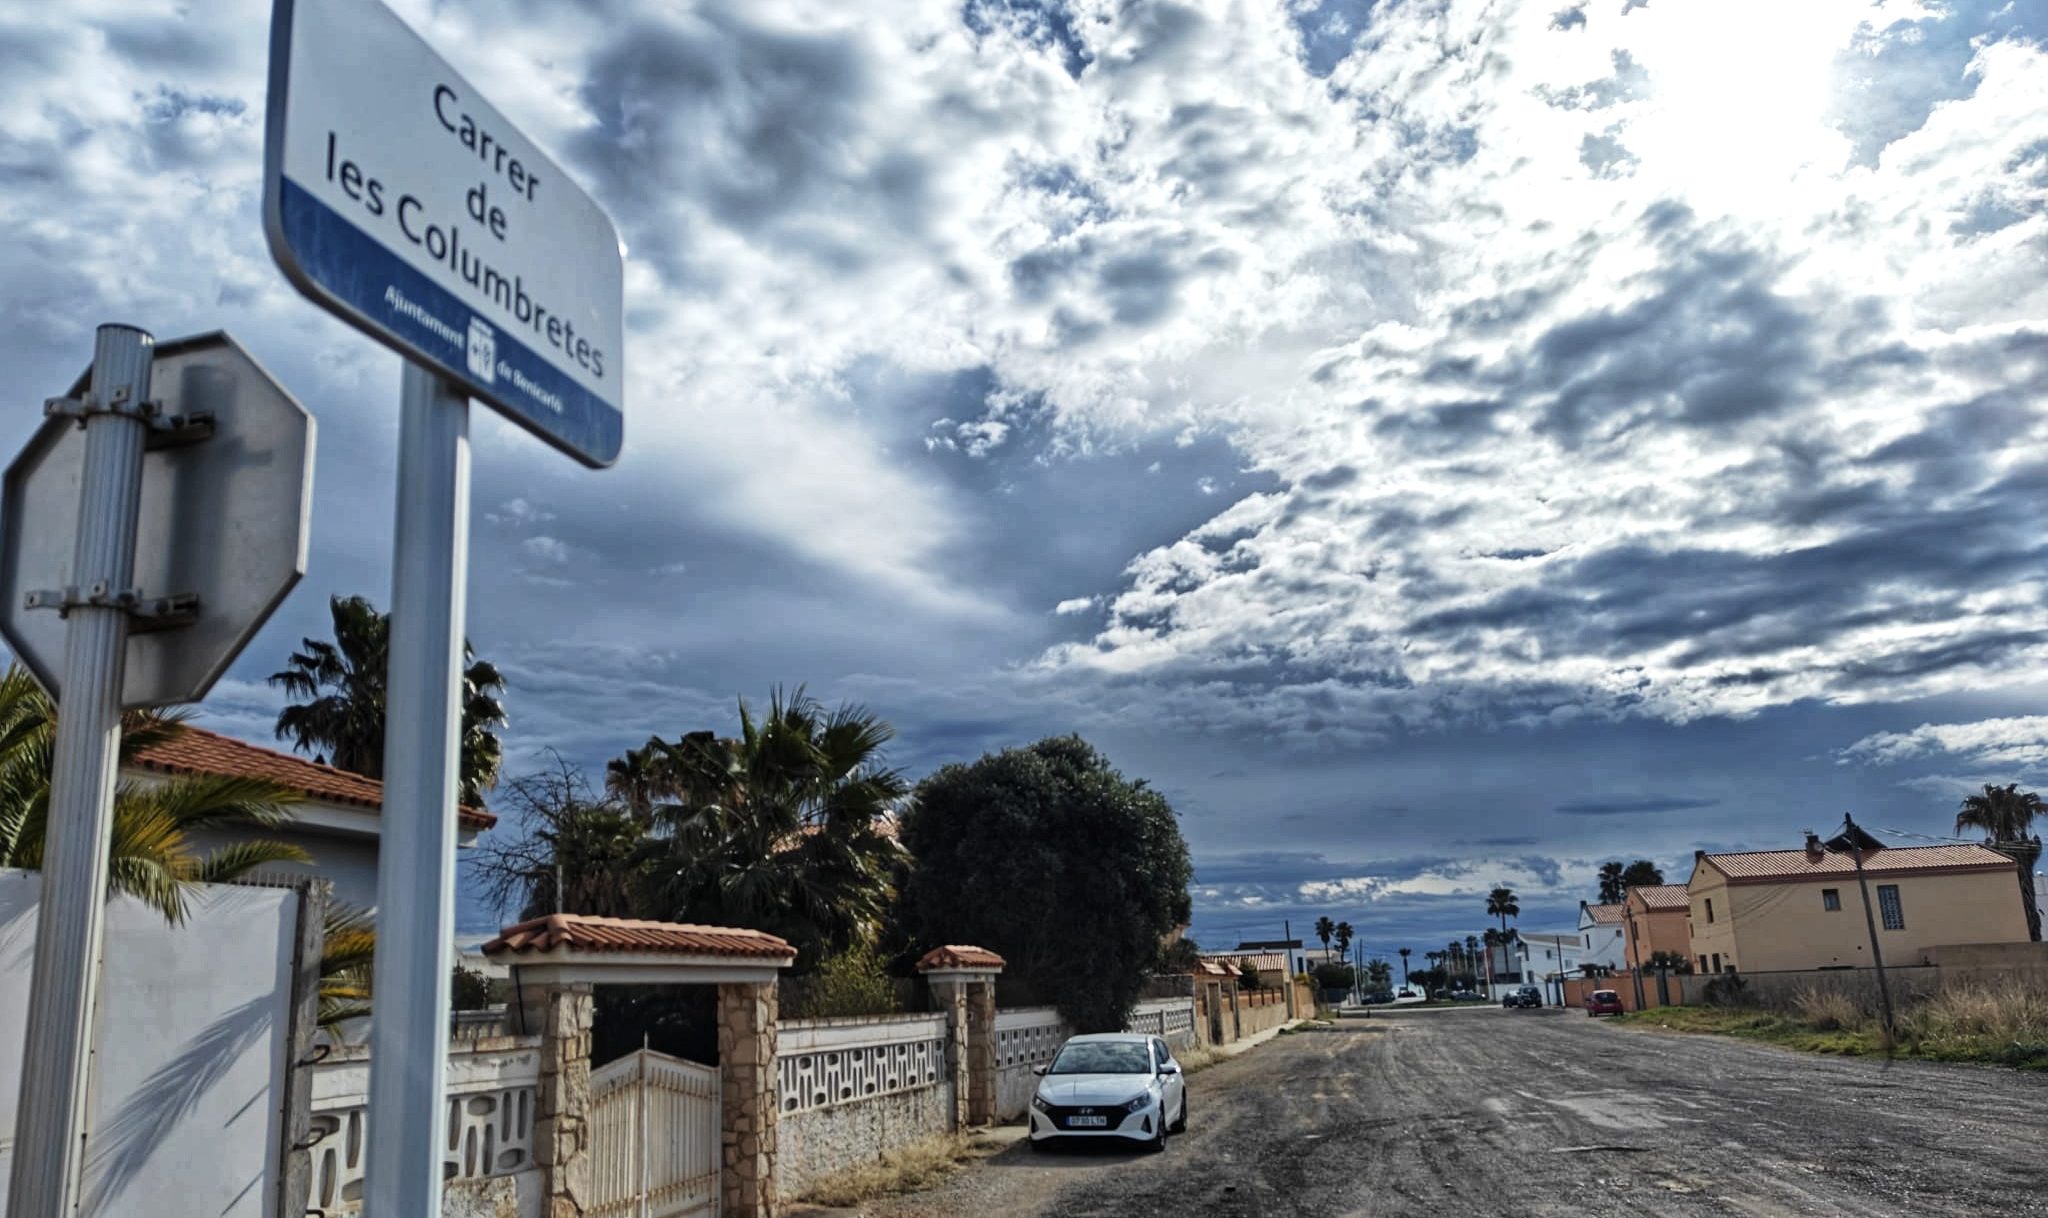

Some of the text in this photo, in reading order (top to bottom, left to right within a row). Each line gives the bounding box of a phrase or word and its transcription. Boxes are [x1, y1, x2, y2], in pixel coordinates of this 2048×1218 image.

[433, 83, 540, 202] Carrer
[326, 130, 604, 379] les Columbretes
[466, 182, 508, 241] de
[384, 284, 465, 349] Ajuntament
